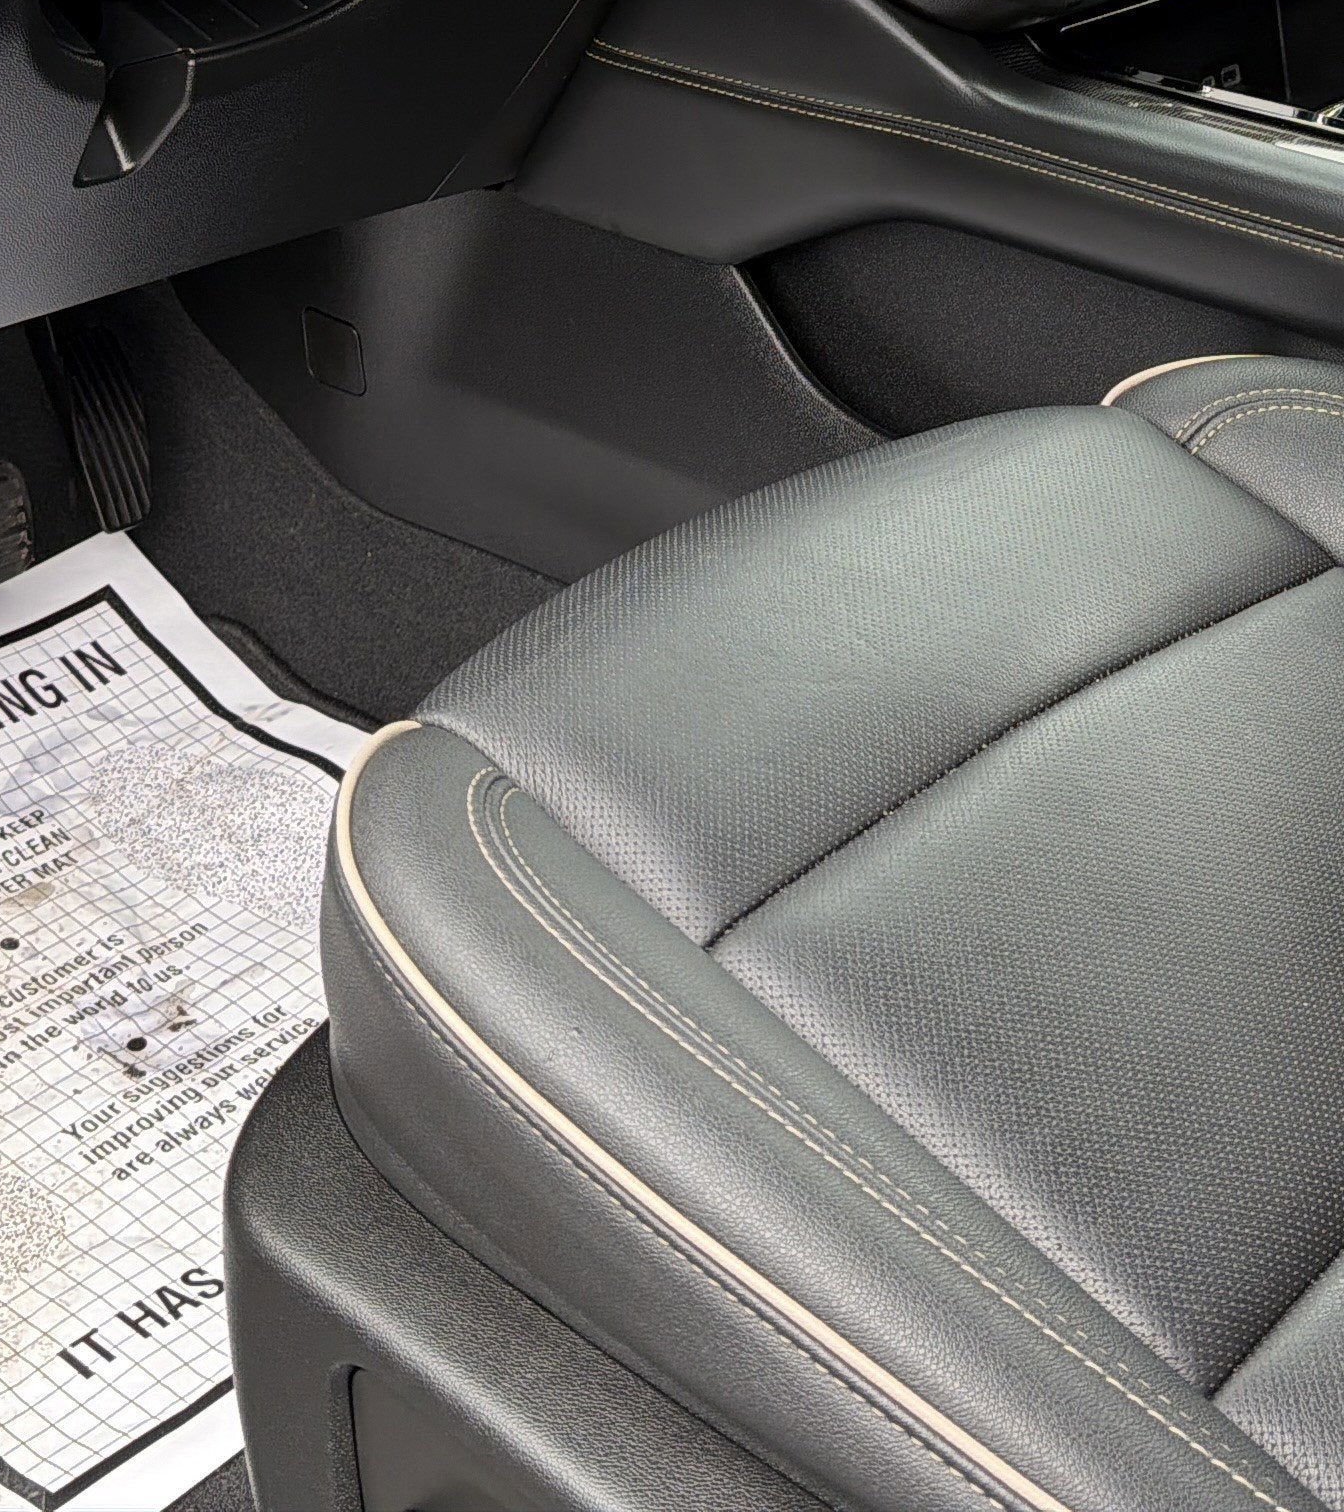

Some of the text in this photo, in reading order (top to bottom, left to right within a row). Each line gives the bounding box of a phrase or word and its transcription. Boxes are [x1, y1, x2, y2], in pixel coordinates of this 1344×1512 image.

[58, 640, 128, 693] IN
[1, 827, 73, 867] CLEAN
[31, 850, 80, 880] MAT
[25, 954, 138, 1019] important
[137, 922, 210, 964] person
[99, 933, 126, 953] is
[20, 1025, 64, 1052] the
[62, 989, 129, 1027] world
[125, 976, 154, 995] to
[60, 1004, 289, 1141] Your suggestions for
[78, 1015, 321, 1165] improving our service
[112, 1150, 156, 1182] are
[155, 1097, 238, 1154] always
[56, 1267, 225, 1380] IT HAS
